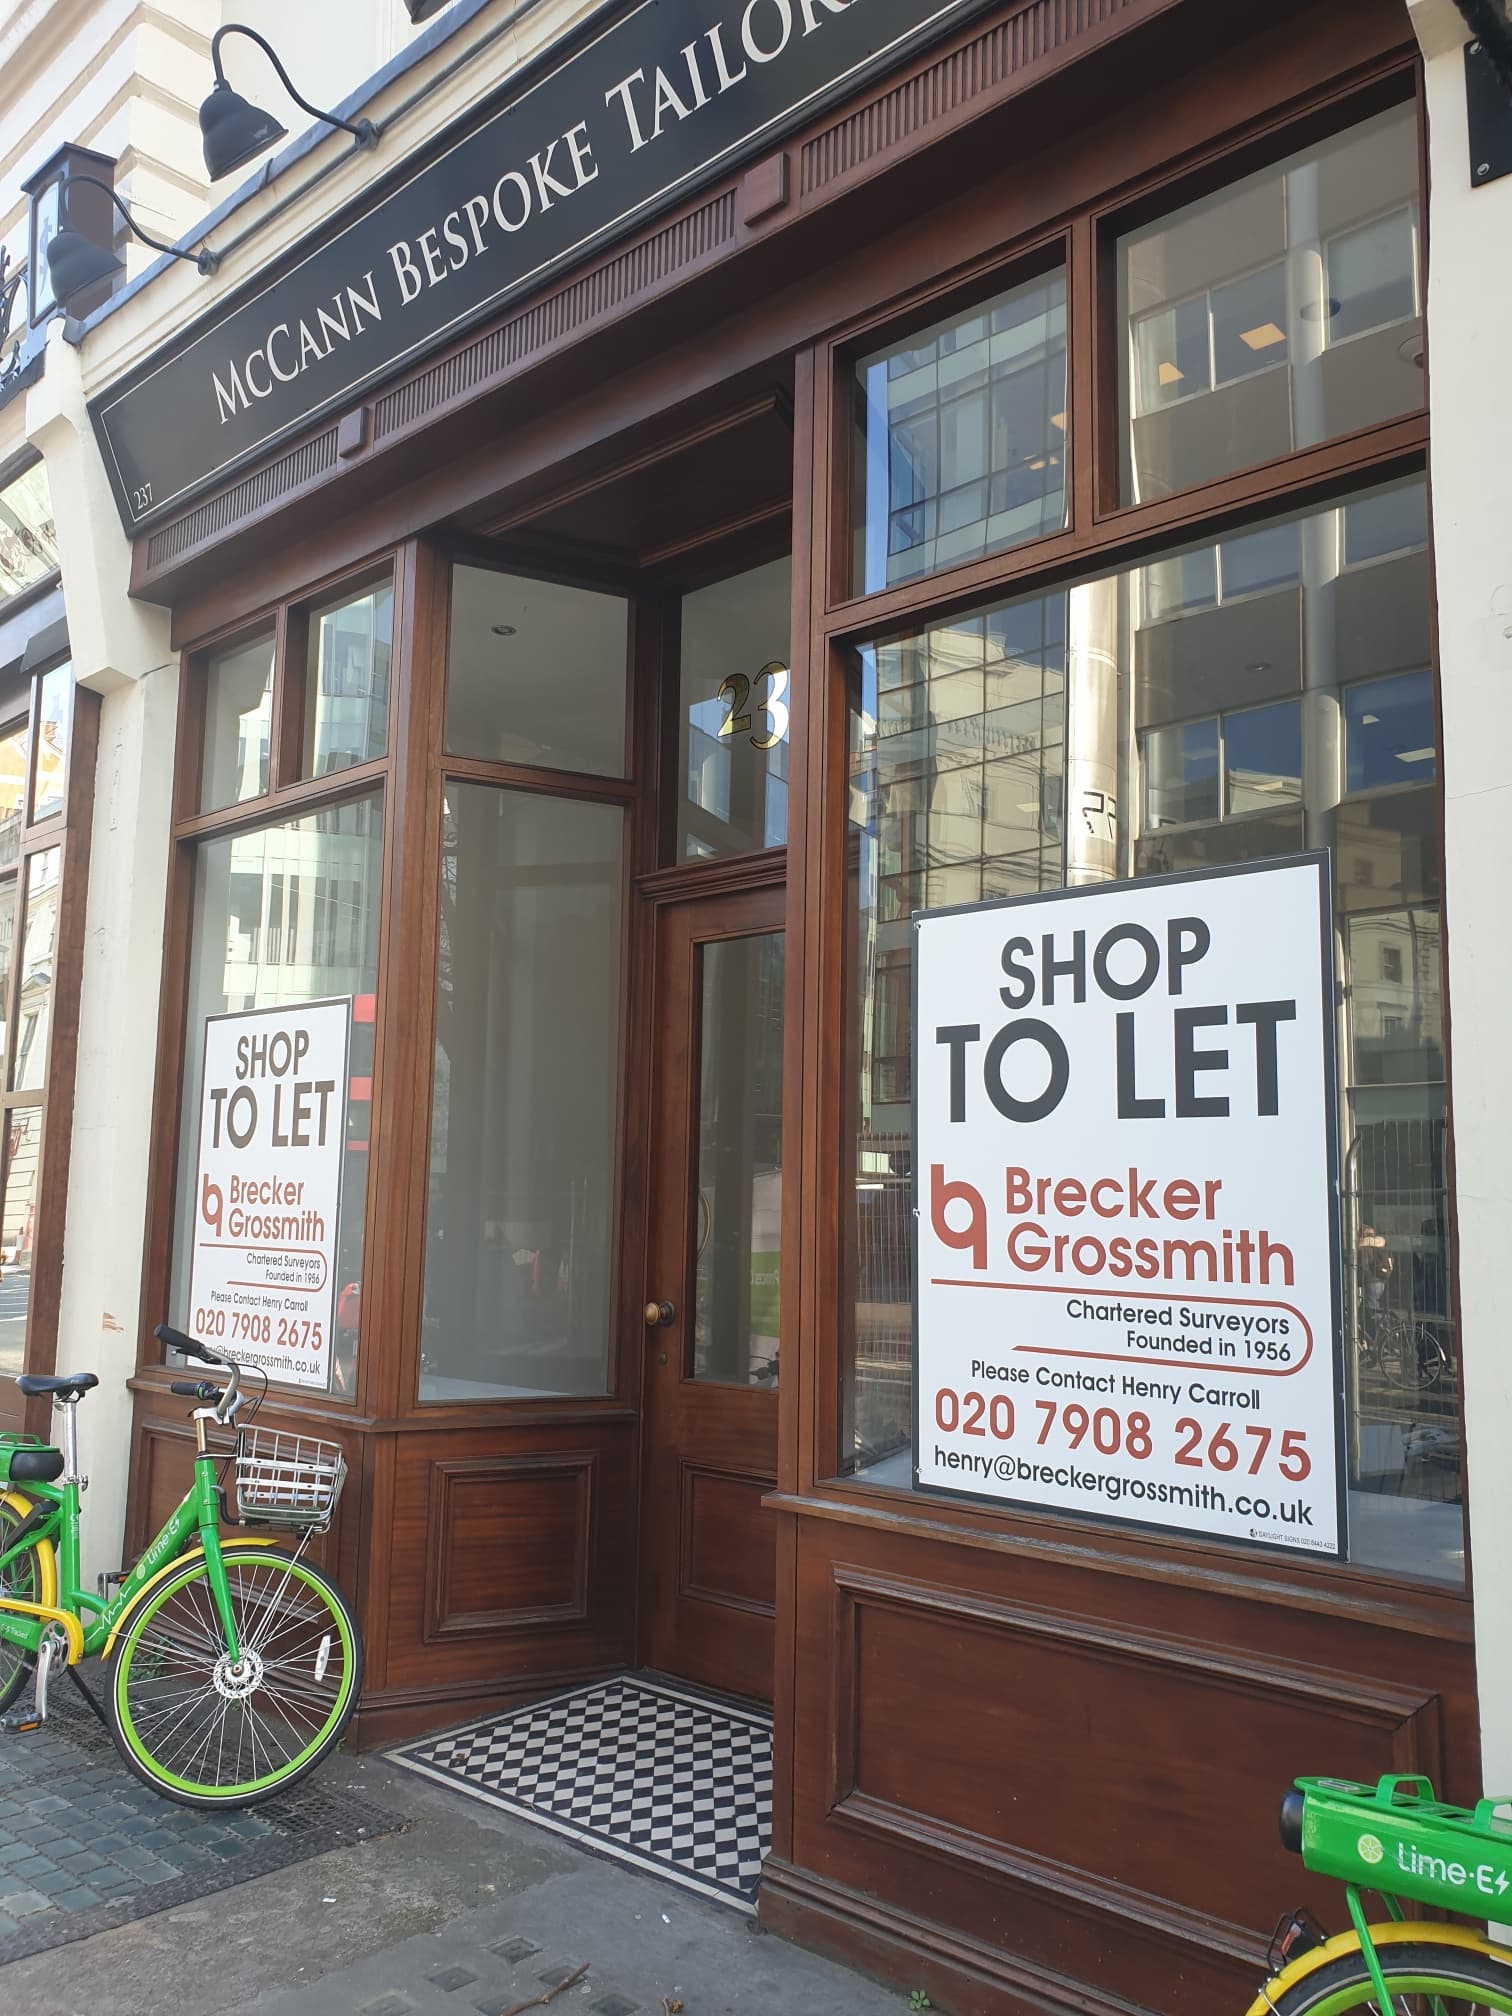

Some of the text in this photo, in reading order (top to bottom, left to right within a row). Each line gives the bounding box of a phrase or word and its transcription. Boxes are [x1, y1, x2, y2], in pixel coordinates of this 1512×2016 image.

[386, 120, 599, 307] BESPOKE
[133, 482, 153, 510] 237
[999, 916, 1211, 1010] SHOP
[235, 1029, 310, 1081] SHOP
[935, 999, 1297, 1124] TO LET
[210, 1080, 336, 1149] TO LET
[229, 1174, 305, 1206] Brecker
[1005, 1166, 1223, 1221] Brecker
[228, 1207, 325, 1242] Grossmith
[246, 1252, 321, 1271] Chartered Surveyors
[265, 1269, 320, 1285] Founded in 1956
[1006, 1221, 1295, 1287] Grossmith
[210, 1290, 308, 1312] Please Contact Henry Carroll
[1065, 1298, 1290, 1336] Chartered Surveyors
[195, 1307, 323, 1351] 020 7908 2675
[1126, 1329, 1292, 1362] Founded in 1956
[971, 1359, 1260, 1410] Please Contact Henry Carroll
[935, 1387, 1313, 1482] 020 7908 2675
[934, 1445, 1313, 1527] henry@breckergrossmith.co.uk
